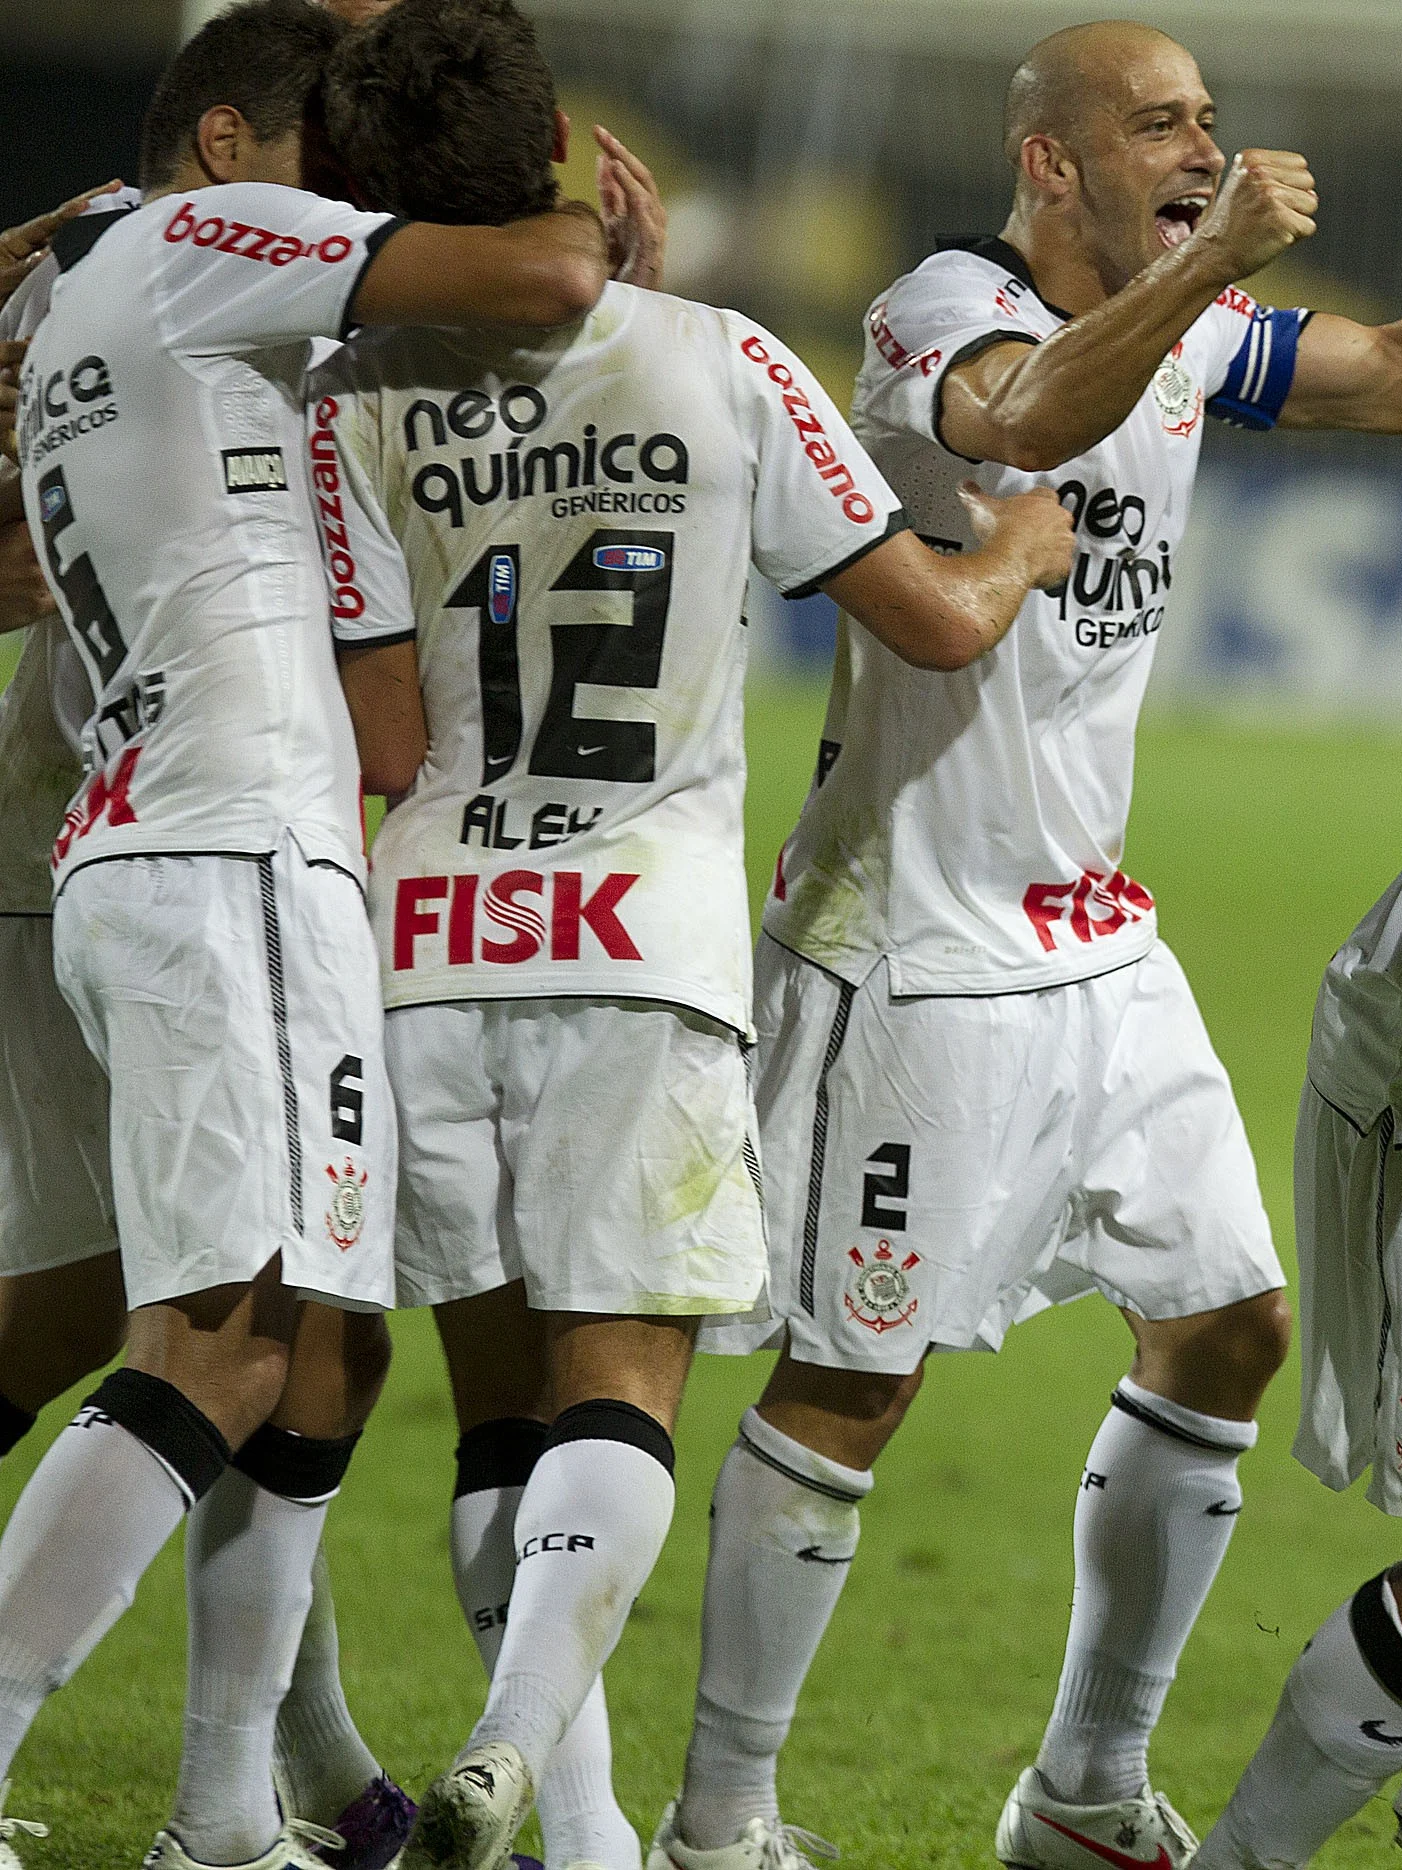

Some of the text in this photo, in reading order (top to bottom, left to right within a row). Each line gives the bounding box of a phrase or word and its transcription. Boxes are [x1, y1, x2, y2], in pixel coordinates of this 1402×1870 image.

[404, 384, 547, 451] neo
[740, 335, 874, 525] bozzano
[308, 396, 366, 619] bozzano
[412, 424, 688, 528] química
[551, 487, 686, 519] GENÉRICOS
[1057, 480, 1145, 546] neo
[443, 528, 675, 787] 12
[393, 869, 644, 971] FISK
[330, 1053, 363, 1147] 6
[861, 1142, 911, 1231] 2
